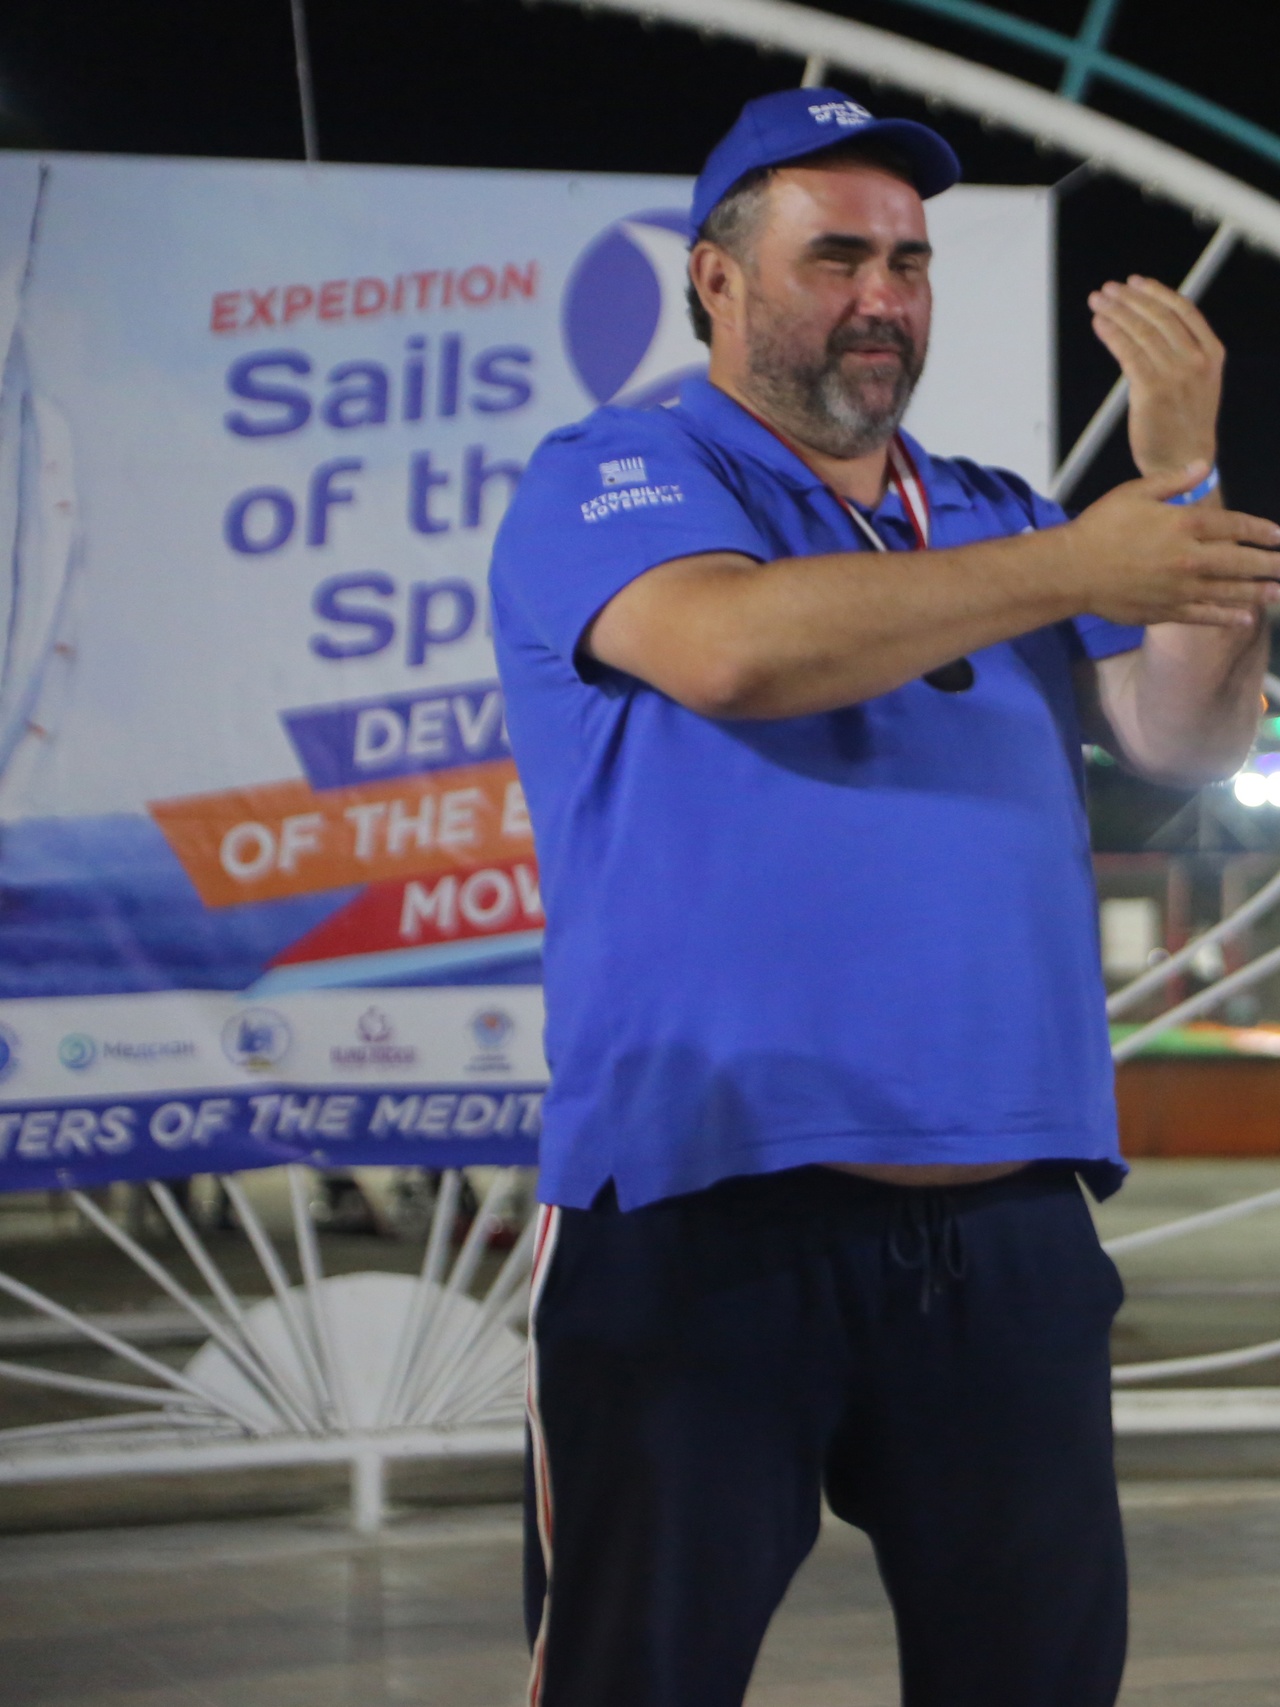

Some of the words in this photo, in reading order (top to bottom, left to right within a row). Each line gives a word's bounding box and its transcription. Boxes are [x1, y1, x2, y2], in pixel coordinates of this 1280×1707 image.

[209, 260, 540, 336] EXPEDITION
[222, 331, 534, 438] Sails
[222, 455, 364, 557] of
[580, 485, 680, 515] EXTRABILITY
[583, 493, 684, 523] MOVEMENT
[309, 568, 492, 668] Sp
[354, 690, 511, 769] DEV
[219, 811, 325, 883] OF
[344, 786, 482, 861] THE
[149, 1099, 234, 1149] OF
[248, 1092, 362, 1137] THE
